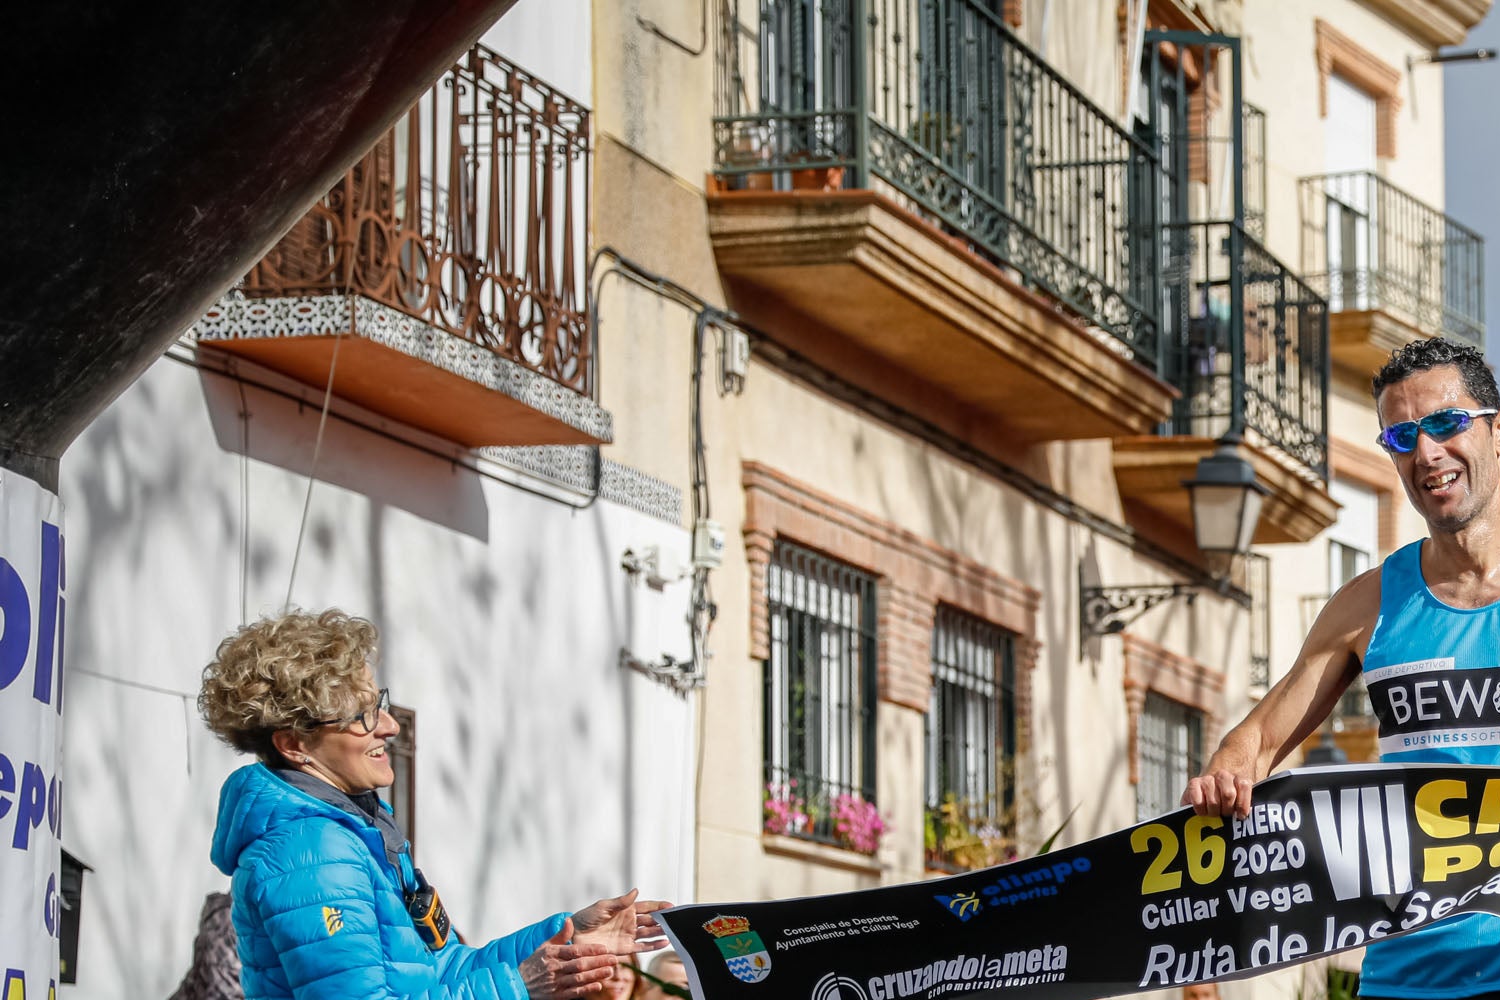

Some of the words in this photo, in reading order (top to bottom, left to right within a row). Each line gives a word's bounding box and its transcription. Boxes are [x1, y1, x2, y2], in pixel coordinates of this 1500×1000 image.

[1395, 660, 1446, 674] DEPORTIVO
[1232, 801, 1301, 840] ENERO
[1130, 815, 1227, 896] 26
[1232, 838, 1306, 878] 2020
[1311, 783, 1413, 902] VII
[982, 856, 1092, 895] olimpo
[989, 885, 1058, 906] deportes
[1142, 894, 1220, 931] Cúllar
[1228, 883, 1314, 915] Vega
[775, 930, 846, 951] Ayuntamiento
[861, 923, 892, 933] Cúllar
[892, 919, 920, 929] Vega
[838, 920, 852, 928] de
[852, 914, 899, 925] Deportes
[1139, 938, 1236, 988] Ruta
[1250, 925, 1308, 967] de
[1324, 916, 1392, 957] los
[927, 979, 1003, 1000] cronometraje
[1004, 971, 1066, 988] deportivo
